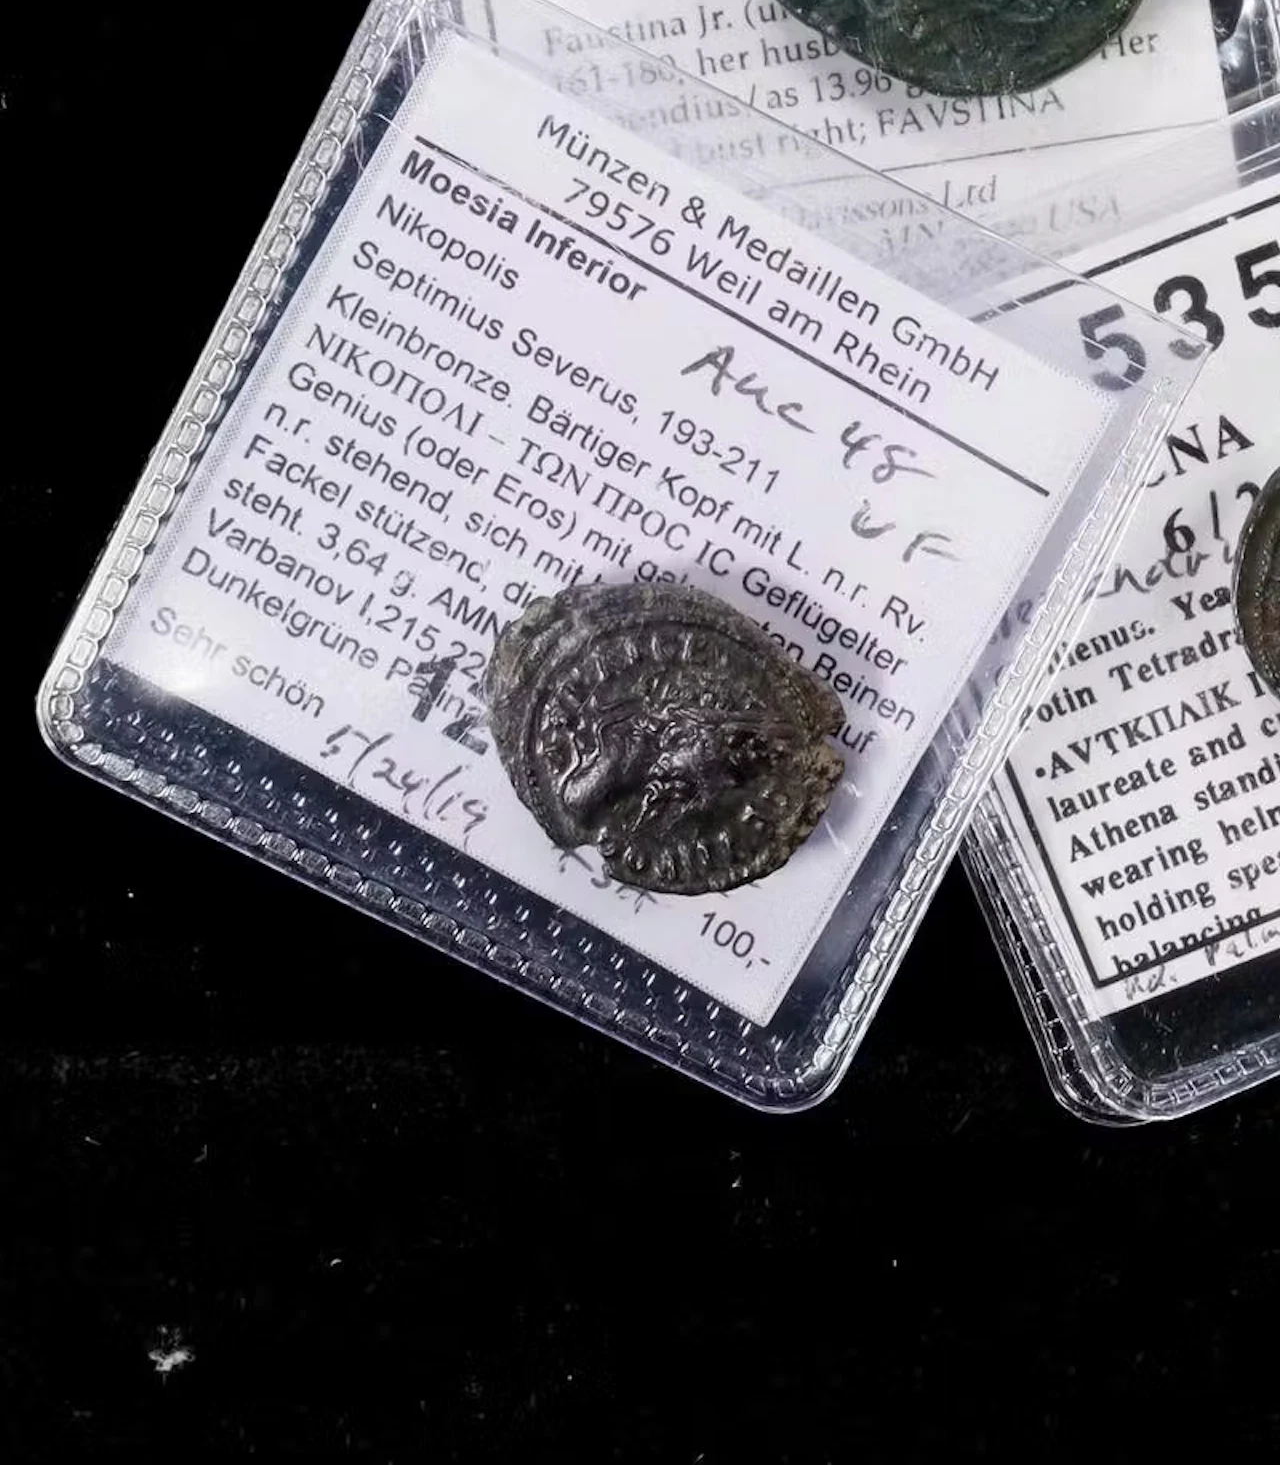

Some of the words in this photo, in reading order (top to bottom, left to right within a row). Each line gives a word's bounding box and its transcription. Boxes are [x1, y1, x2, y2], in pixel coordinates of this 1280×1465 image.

[699, 48, 753, 78] her
[376, 191, 523, 294] Nikopolis
[399, 147, 523, 236] Moesia
[526, 221, 650, 304] Inferior
[536, 112, 673, 210] Münzen
[683, 195, 709, 232] &
[716, 213, 883, 327] Medaillen
[889, 311, 1002, 394] GmbH
[561, 174, 676, 259] 79576
[684, 242, 764, 304] Weil
[766, 291, 827, 341] am
[831, 330, 934, 405] Rhein
[350, 238, 508, 344] Septimius
[509, 324, 645, 423] Severus,
[655, 404, 783, 497] 193-211
[241, 432, 355, 509] Fackel
[355, 490, 492, 593] stützend,
[261, 394, 316, 439] n.r.
[321, 424, 457, 525] stehend,
[459, 502, 531, 564] sich
[531, 539, 586, 591] mit
[286, 358, 402, 436] Genius
[402, 420, 492, 496] (oder
[489, 467, 580, 544] Eros)
[583, 526, 636, 583] mit
[323, 282, 516, 408] Kleinbronze.
[524, 390, 656, 482] Bärtiger
[655, 461, 738, 527] Kopf
[730, 498, 789, 552] mit
[795, 536, 820, 579] L.
[823, 554, 875, 607] n.r.
[878, 594, 930, 646] Rv.
[204, 509, 359, 603] Varbanov
[222, 475, 306, 536] steht.
[313, 518, 392, 576] 3,64
[388, 566, 417, 599] g.
[148, 605, 225, 662] Sehr
[228, 651, 328, 718] schön
[179, 544, 402, 672] Dunkelgrüne
[740, 565, 909, 680] Geflügelter
[812, 652, 917, 734] Beinen
[1046, 756, 1179, 824] laureate
[1187, 727, 1248, 766] and
[1066, 803, 1179, 863] Athena
[1079, 837, 1206, 899] wearing
[1094, 879, 1217, 943] holding
